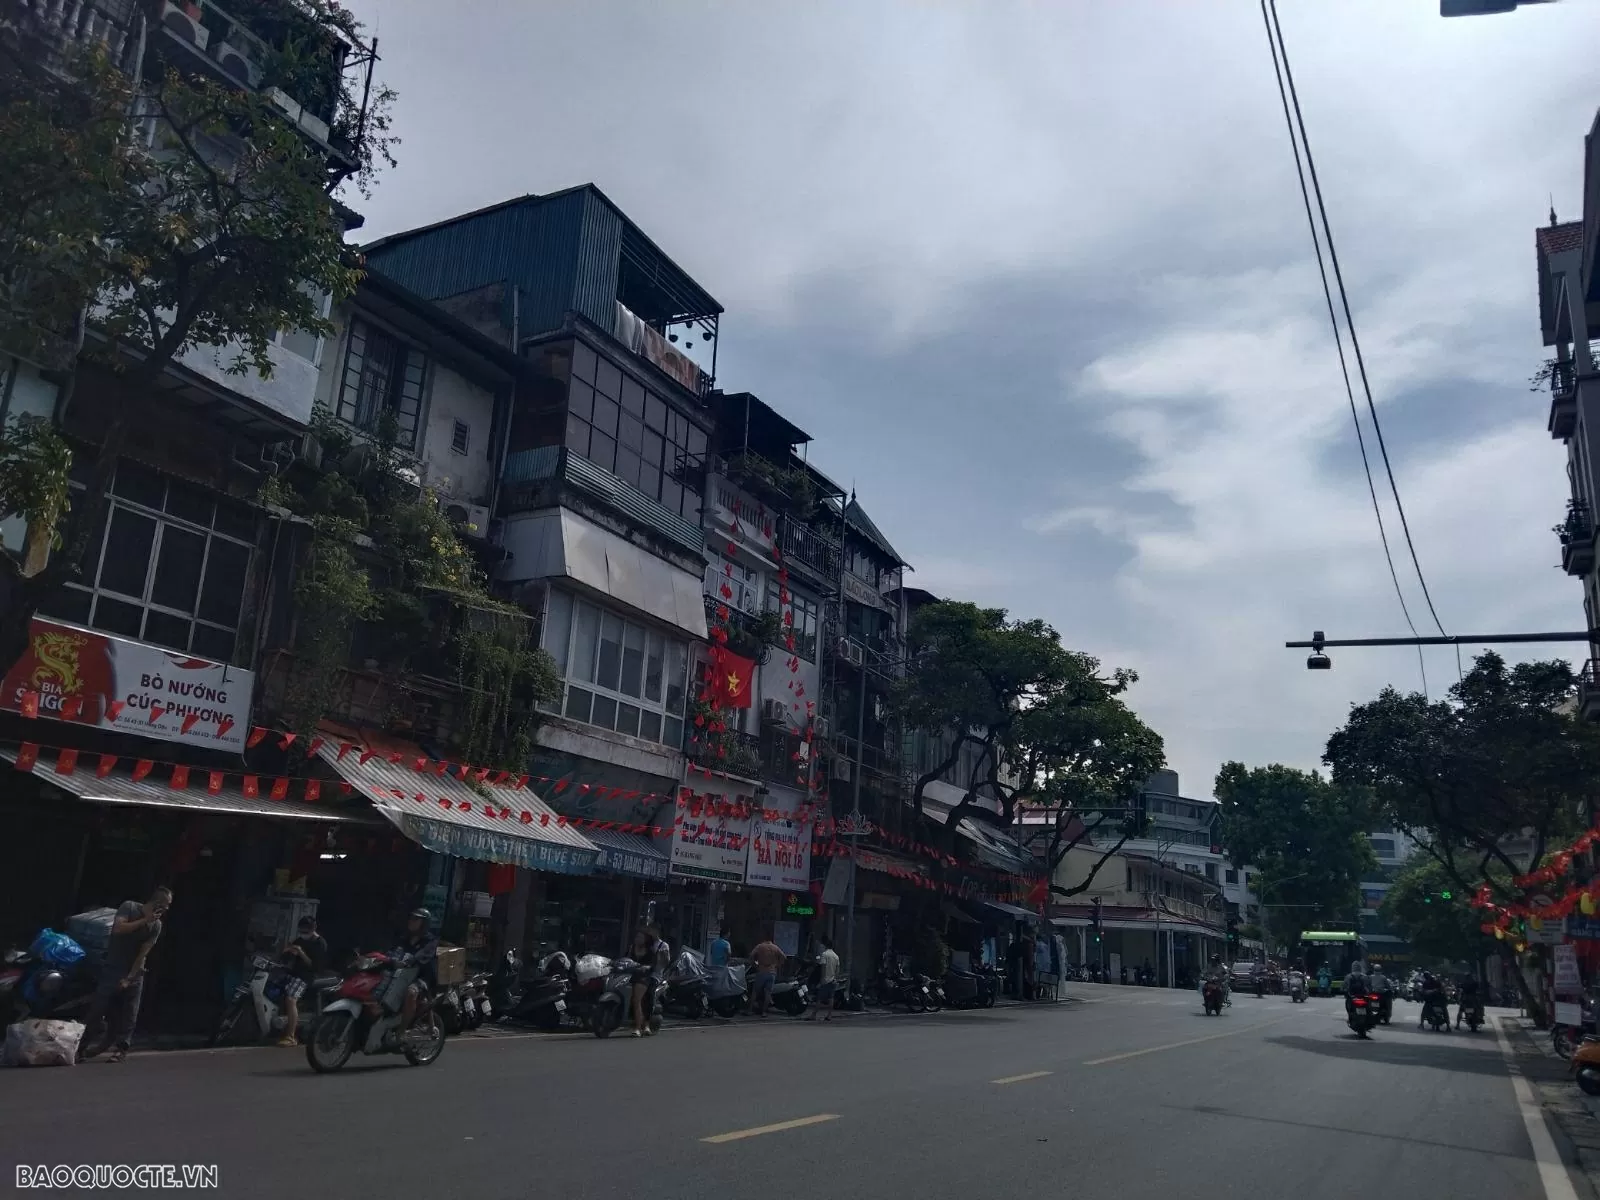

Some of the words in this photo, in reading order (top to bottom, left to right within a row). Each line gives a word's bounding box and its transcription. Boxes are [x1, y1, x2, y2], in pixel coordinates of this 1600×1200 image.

[42, 682, 62, 696] BIA
[140, 673, 163, 690] BÒ
[168, 679, 227, 704] NƯỚNG
